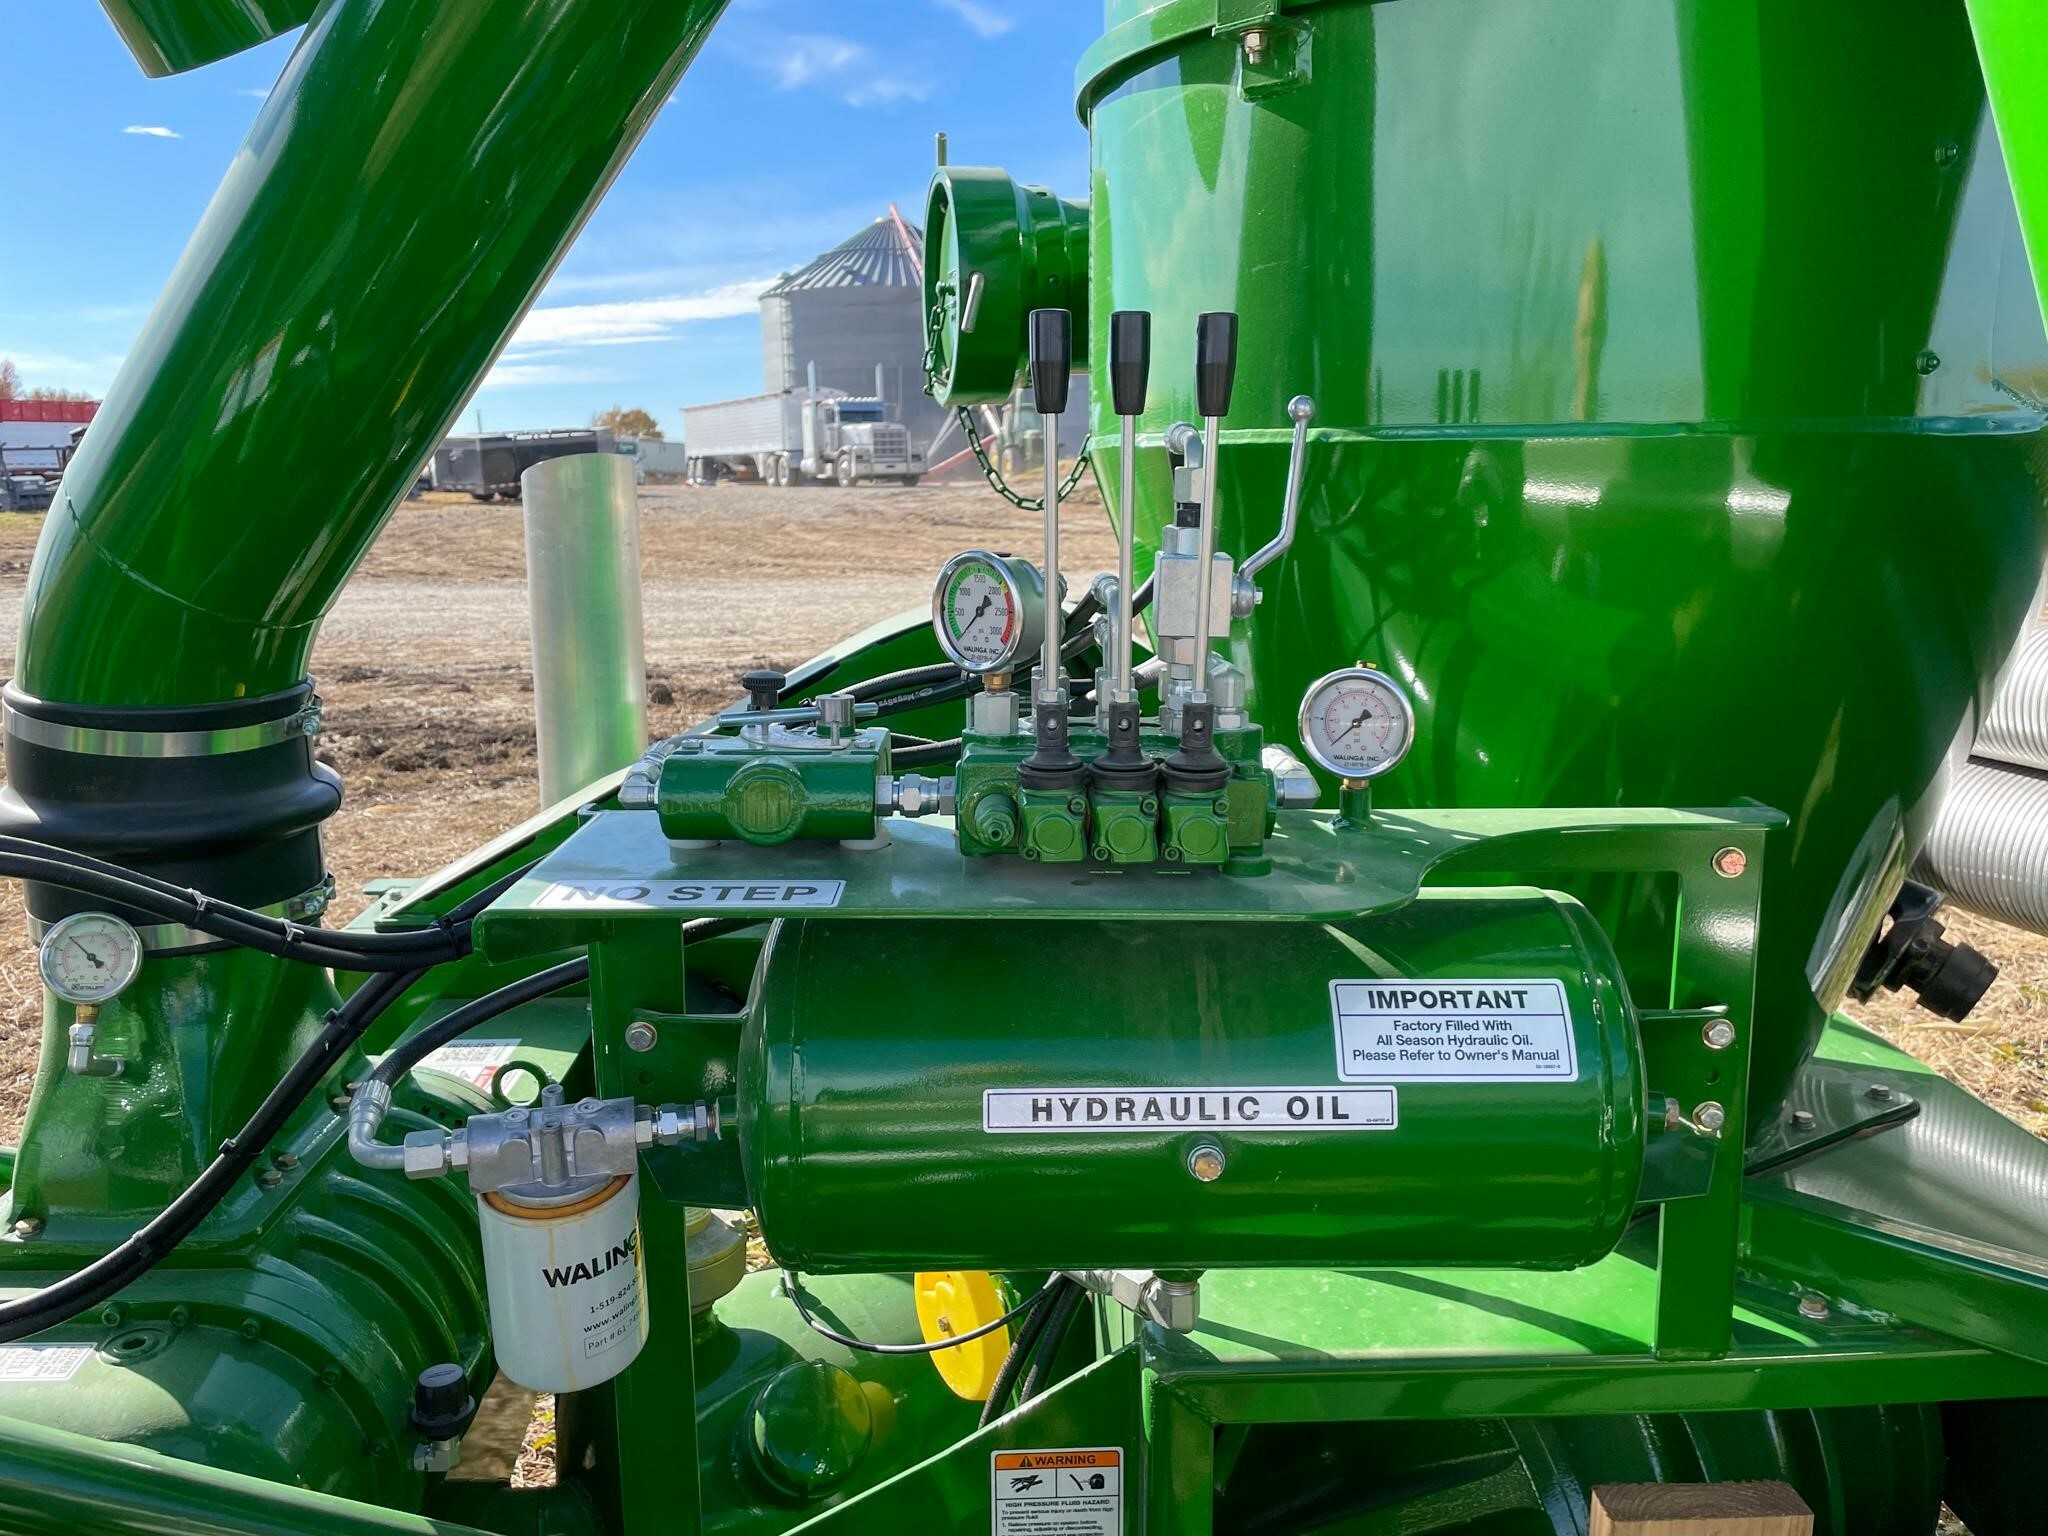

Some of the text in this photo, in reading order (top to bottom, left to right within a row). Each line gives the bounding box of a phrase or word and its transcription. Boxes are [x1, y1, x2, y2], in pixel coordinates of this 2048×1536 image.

[955, 607, 965, 616] 500
[994, 607, 1008, 616] 2500
[990, 626, 1002, 635] 3000
[566, 886, 818, 901] NO STEP
[1367, 990, 1528, 1009] IMPORTANT
[1393, 1020, 1512, 1033] Factory Filled With
[1376, 1034, 1533, 1048] All Season Hydraulic Oil.
[1353, 1049, 1560, 1061] Please Refer to Owner's Manual
[1031, 1095, 1349, 1123] HYDRAULIC OIL
[588, 1337, 607, 1350] Part
[1035, 1455, 1096, 1465] WARNING
